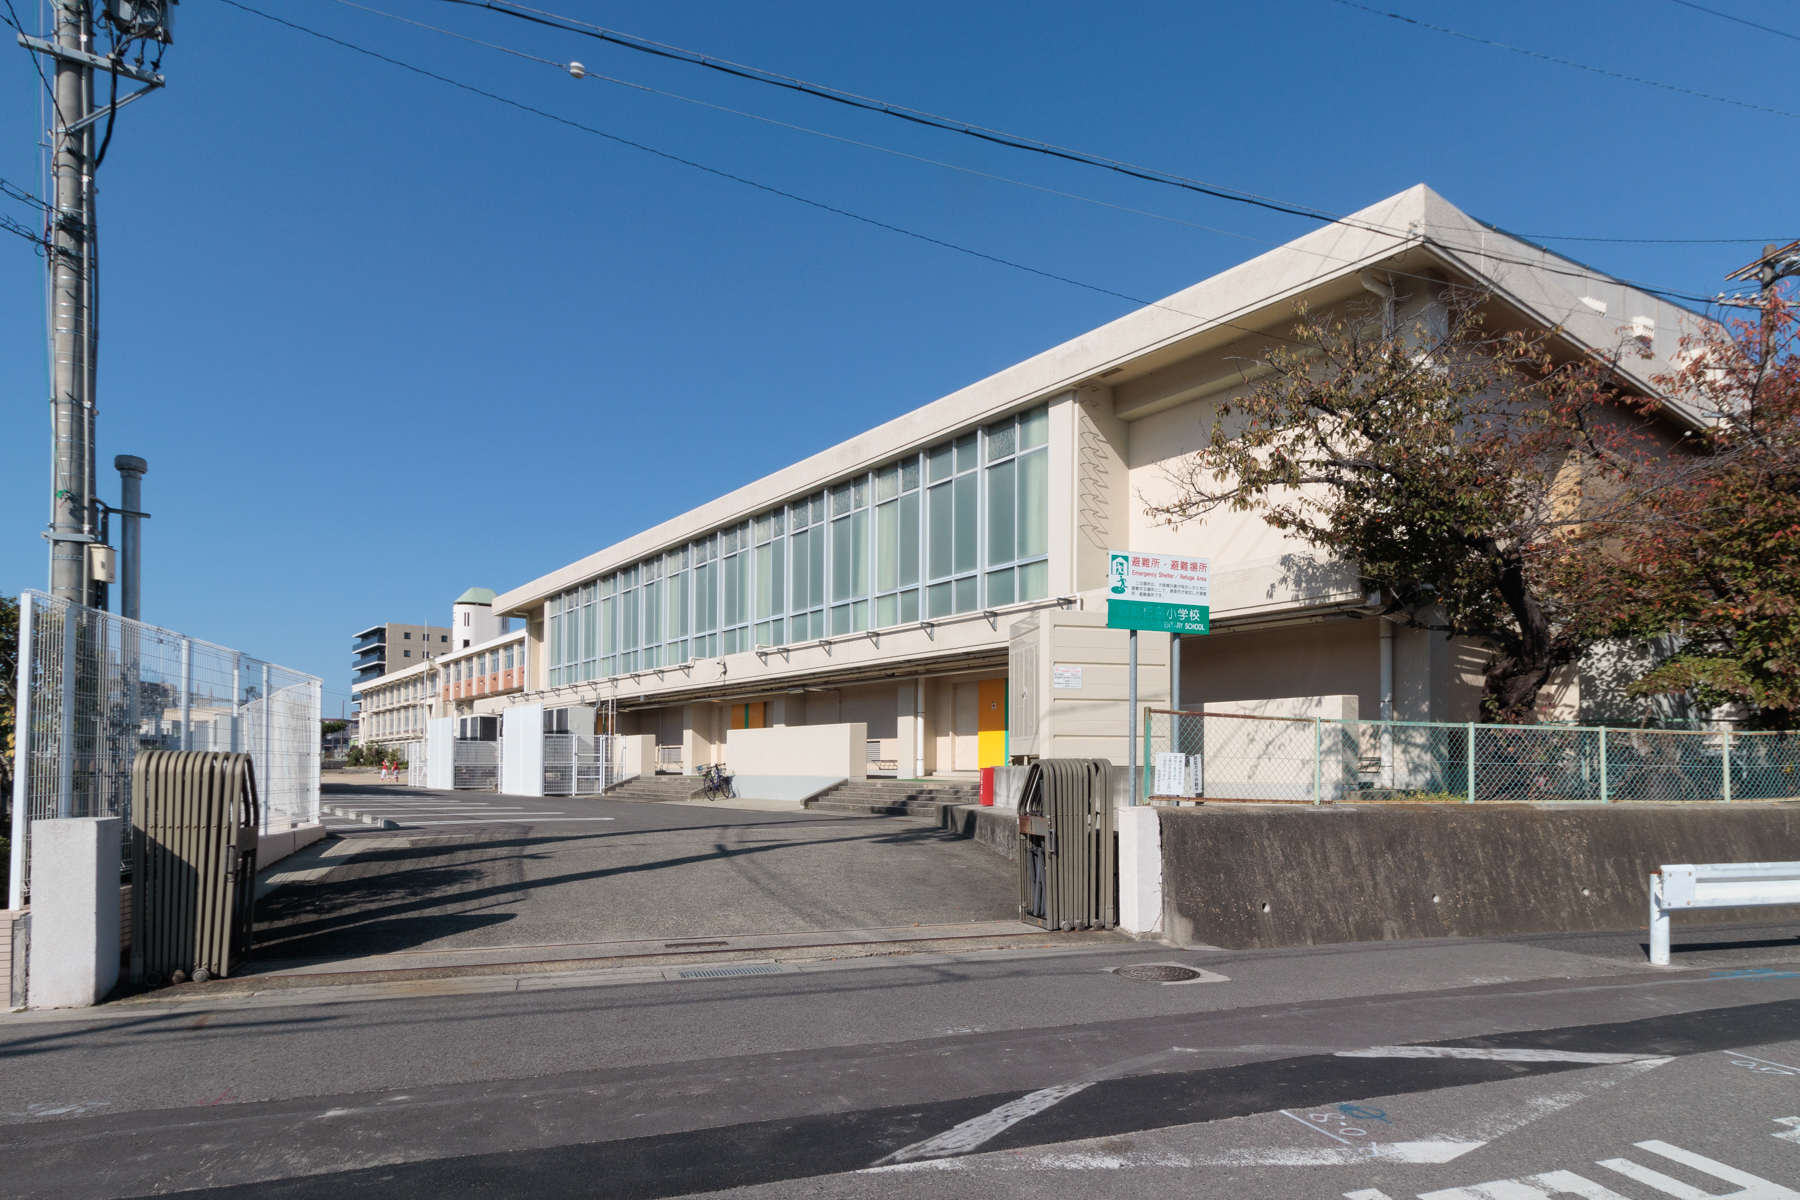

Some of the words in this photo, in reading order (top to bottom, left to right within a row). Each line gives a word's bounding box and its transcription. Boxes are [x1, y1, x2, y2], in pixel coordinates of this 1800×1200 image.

[1131, 556, 1208, 573] 避難所・避難場所
[1132, 569, 1157, 578] Emergency
[1158, 571, 1174, 579] Shelter
[1179, 573, 1195, 581] Refuge
[1184, 622, 1206, 631] SCHOOL
